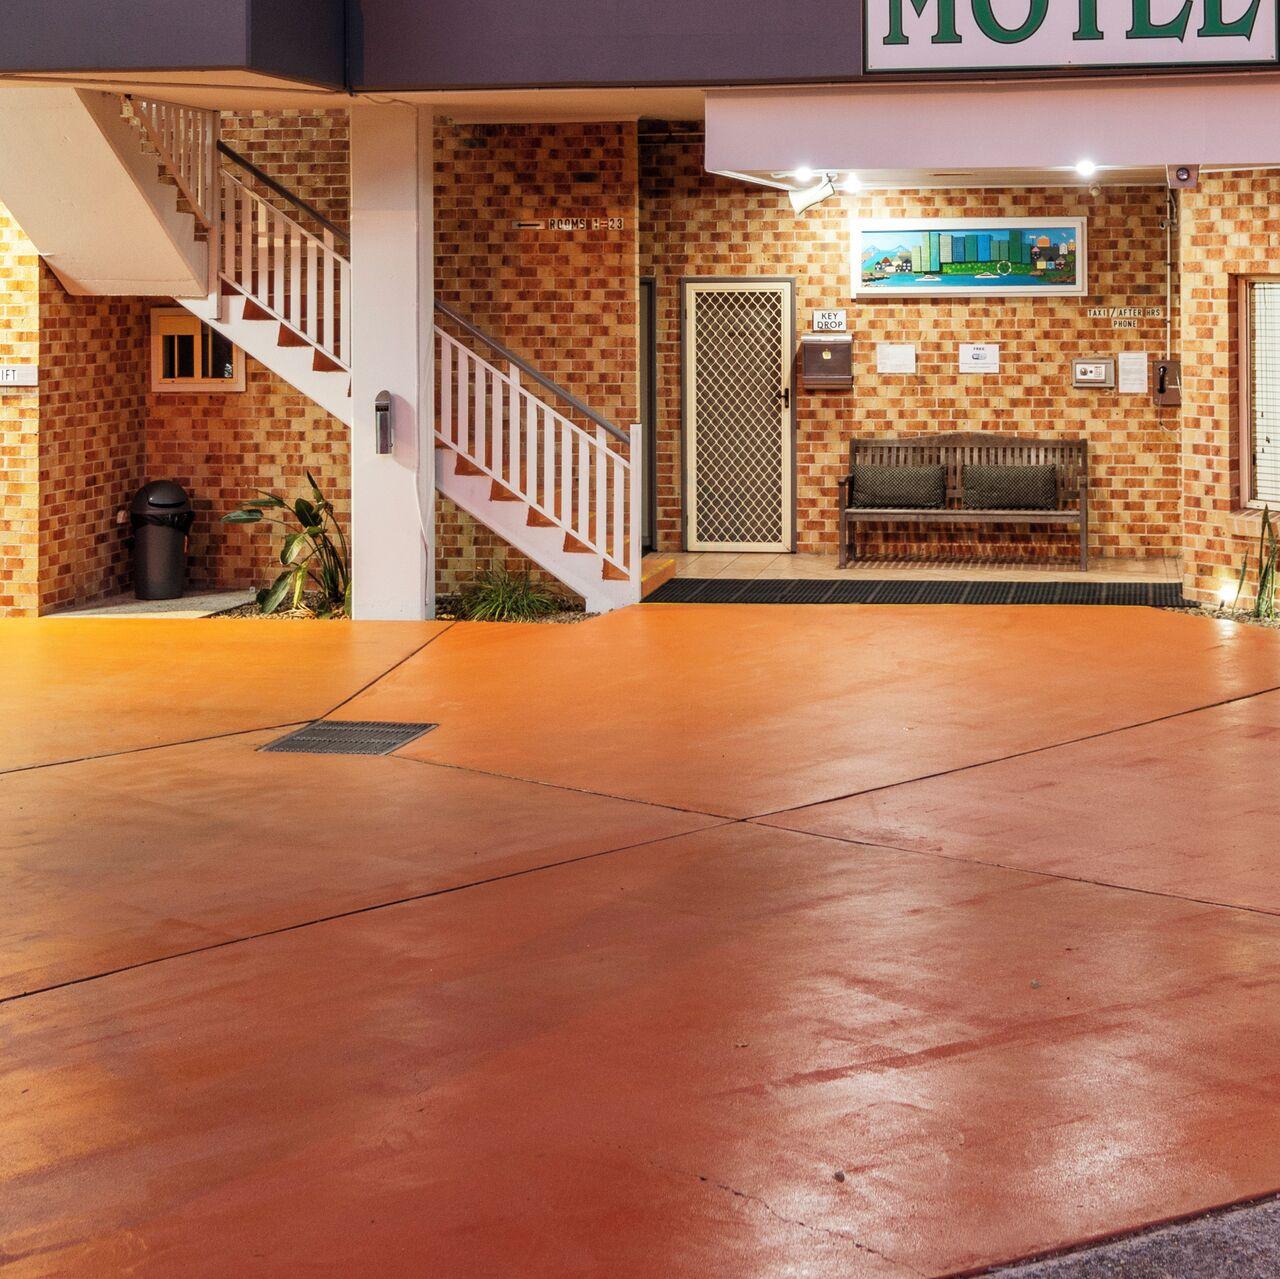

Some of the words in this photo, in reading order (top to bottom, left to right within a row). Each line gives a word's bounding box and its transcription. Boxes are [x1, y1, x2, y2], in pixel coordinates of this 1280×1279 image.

[549, 218, 586, 230] ROOMS
[1119, 308, 1143, 316] AFTER
[1146, 308, 1160, 316] HRS
[817, 321, 843, 329] DROP
